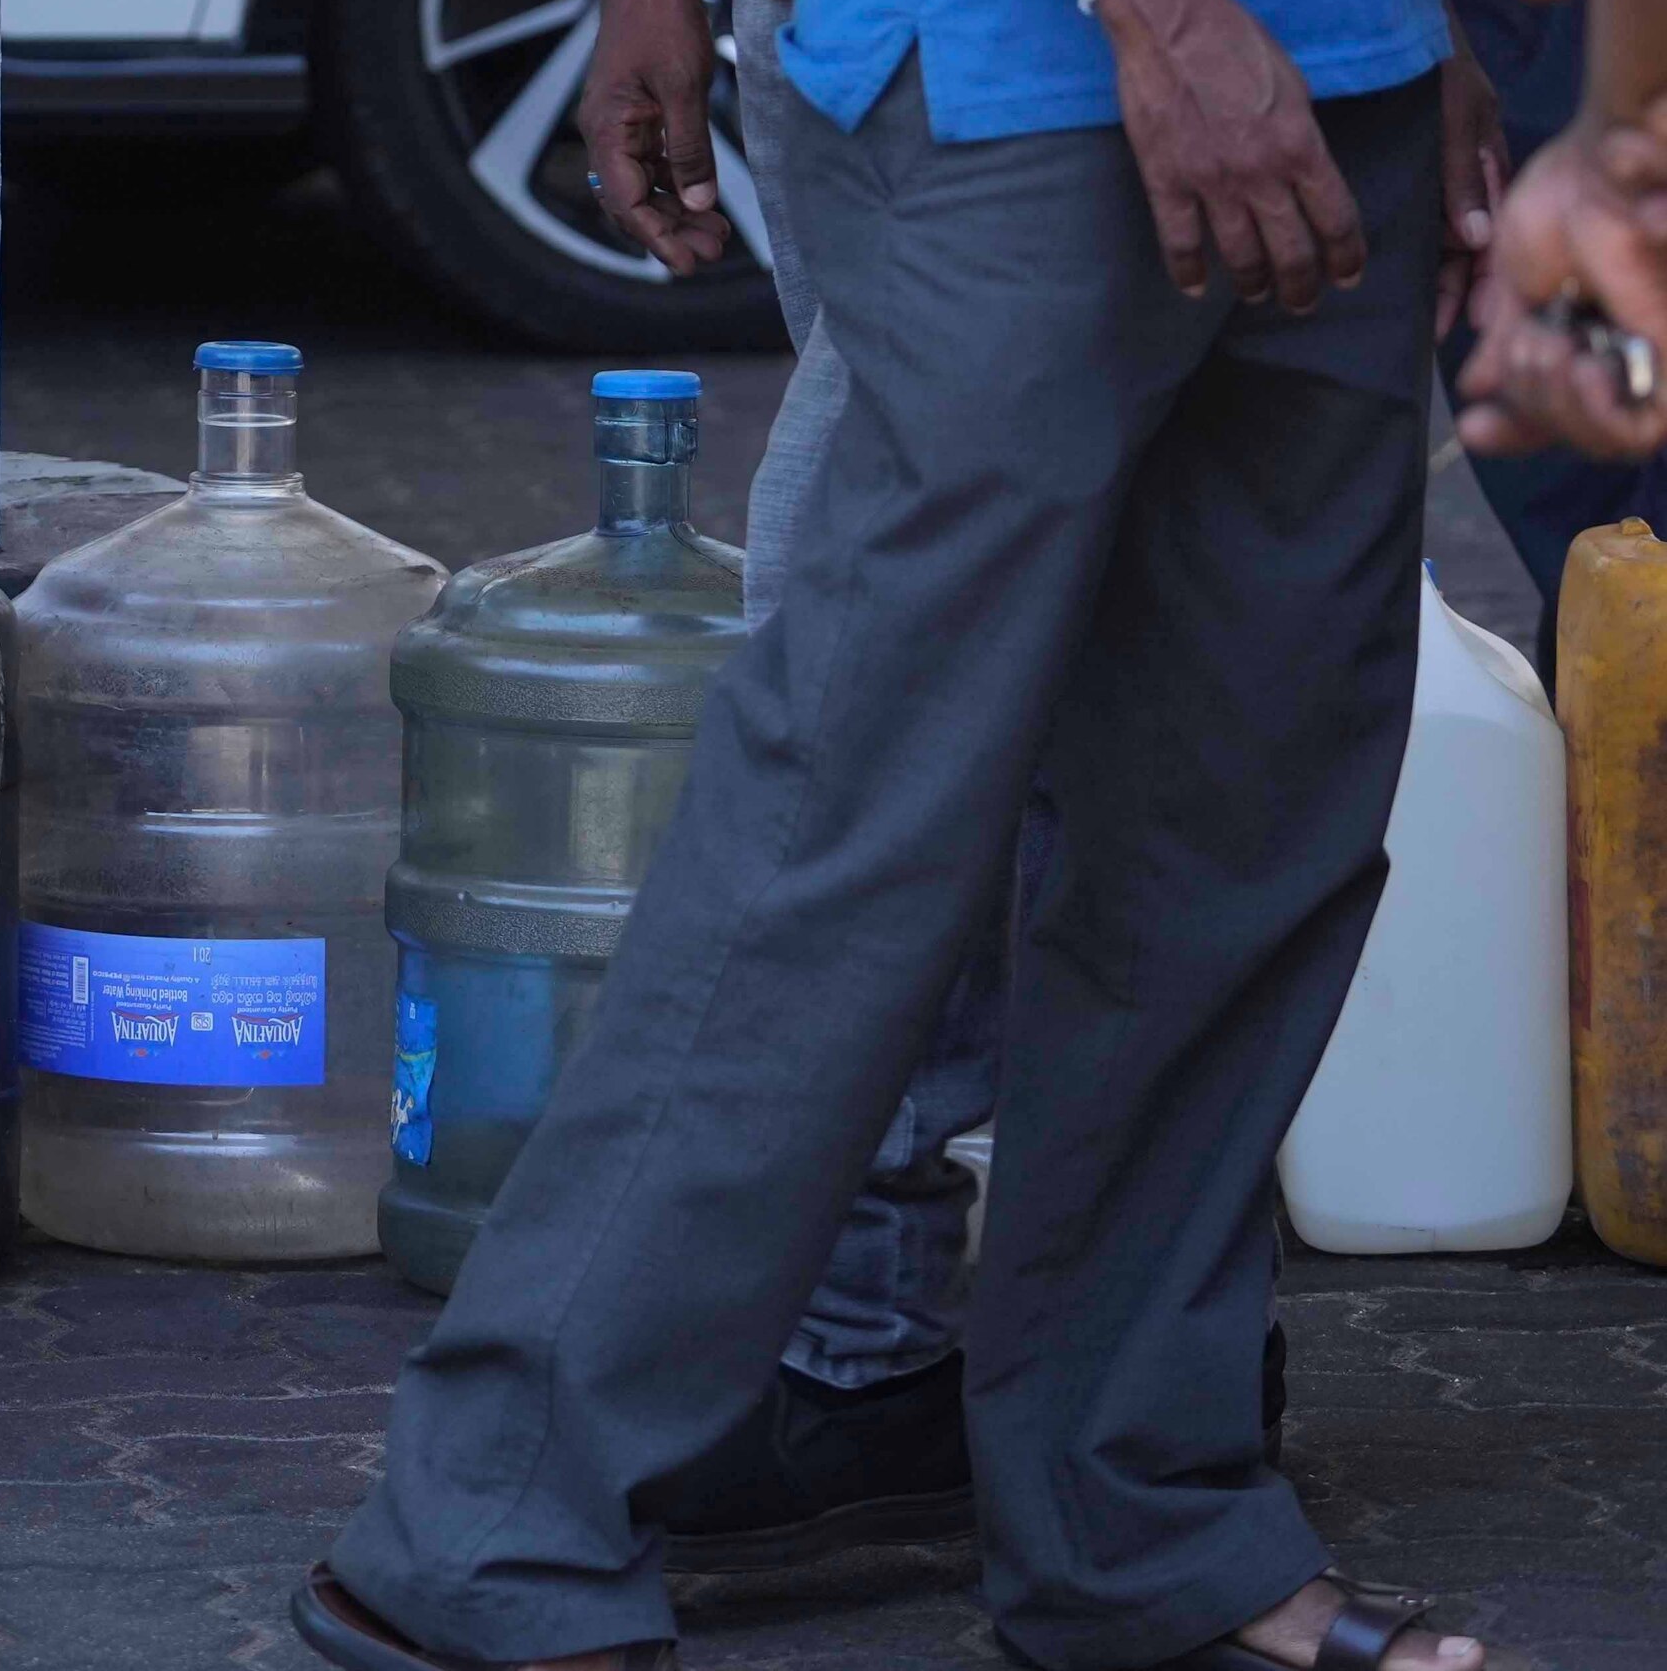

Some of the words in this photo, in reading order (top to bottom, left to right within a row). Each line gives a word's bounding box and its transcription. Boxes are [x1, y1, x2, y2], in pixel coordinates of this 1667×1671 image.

[92, 970, 122, 980] PEPSICO
[102, 985, 124, 998] Water
[126, 983, 158, 1001] Drinking
[159, 988, 188, 1002] Bottled
[116, 1001, 152, 1010] Guaranteed
[153, 1003, 172, 1011] Purity
[236, 1006, 277, 1014] Guaranteed
[278, 1005, 298, 1013] Purity
[111, 1010, 180, 1047] AQUAFINA
[230, 1015, 304, 1047] AQUAFINA
